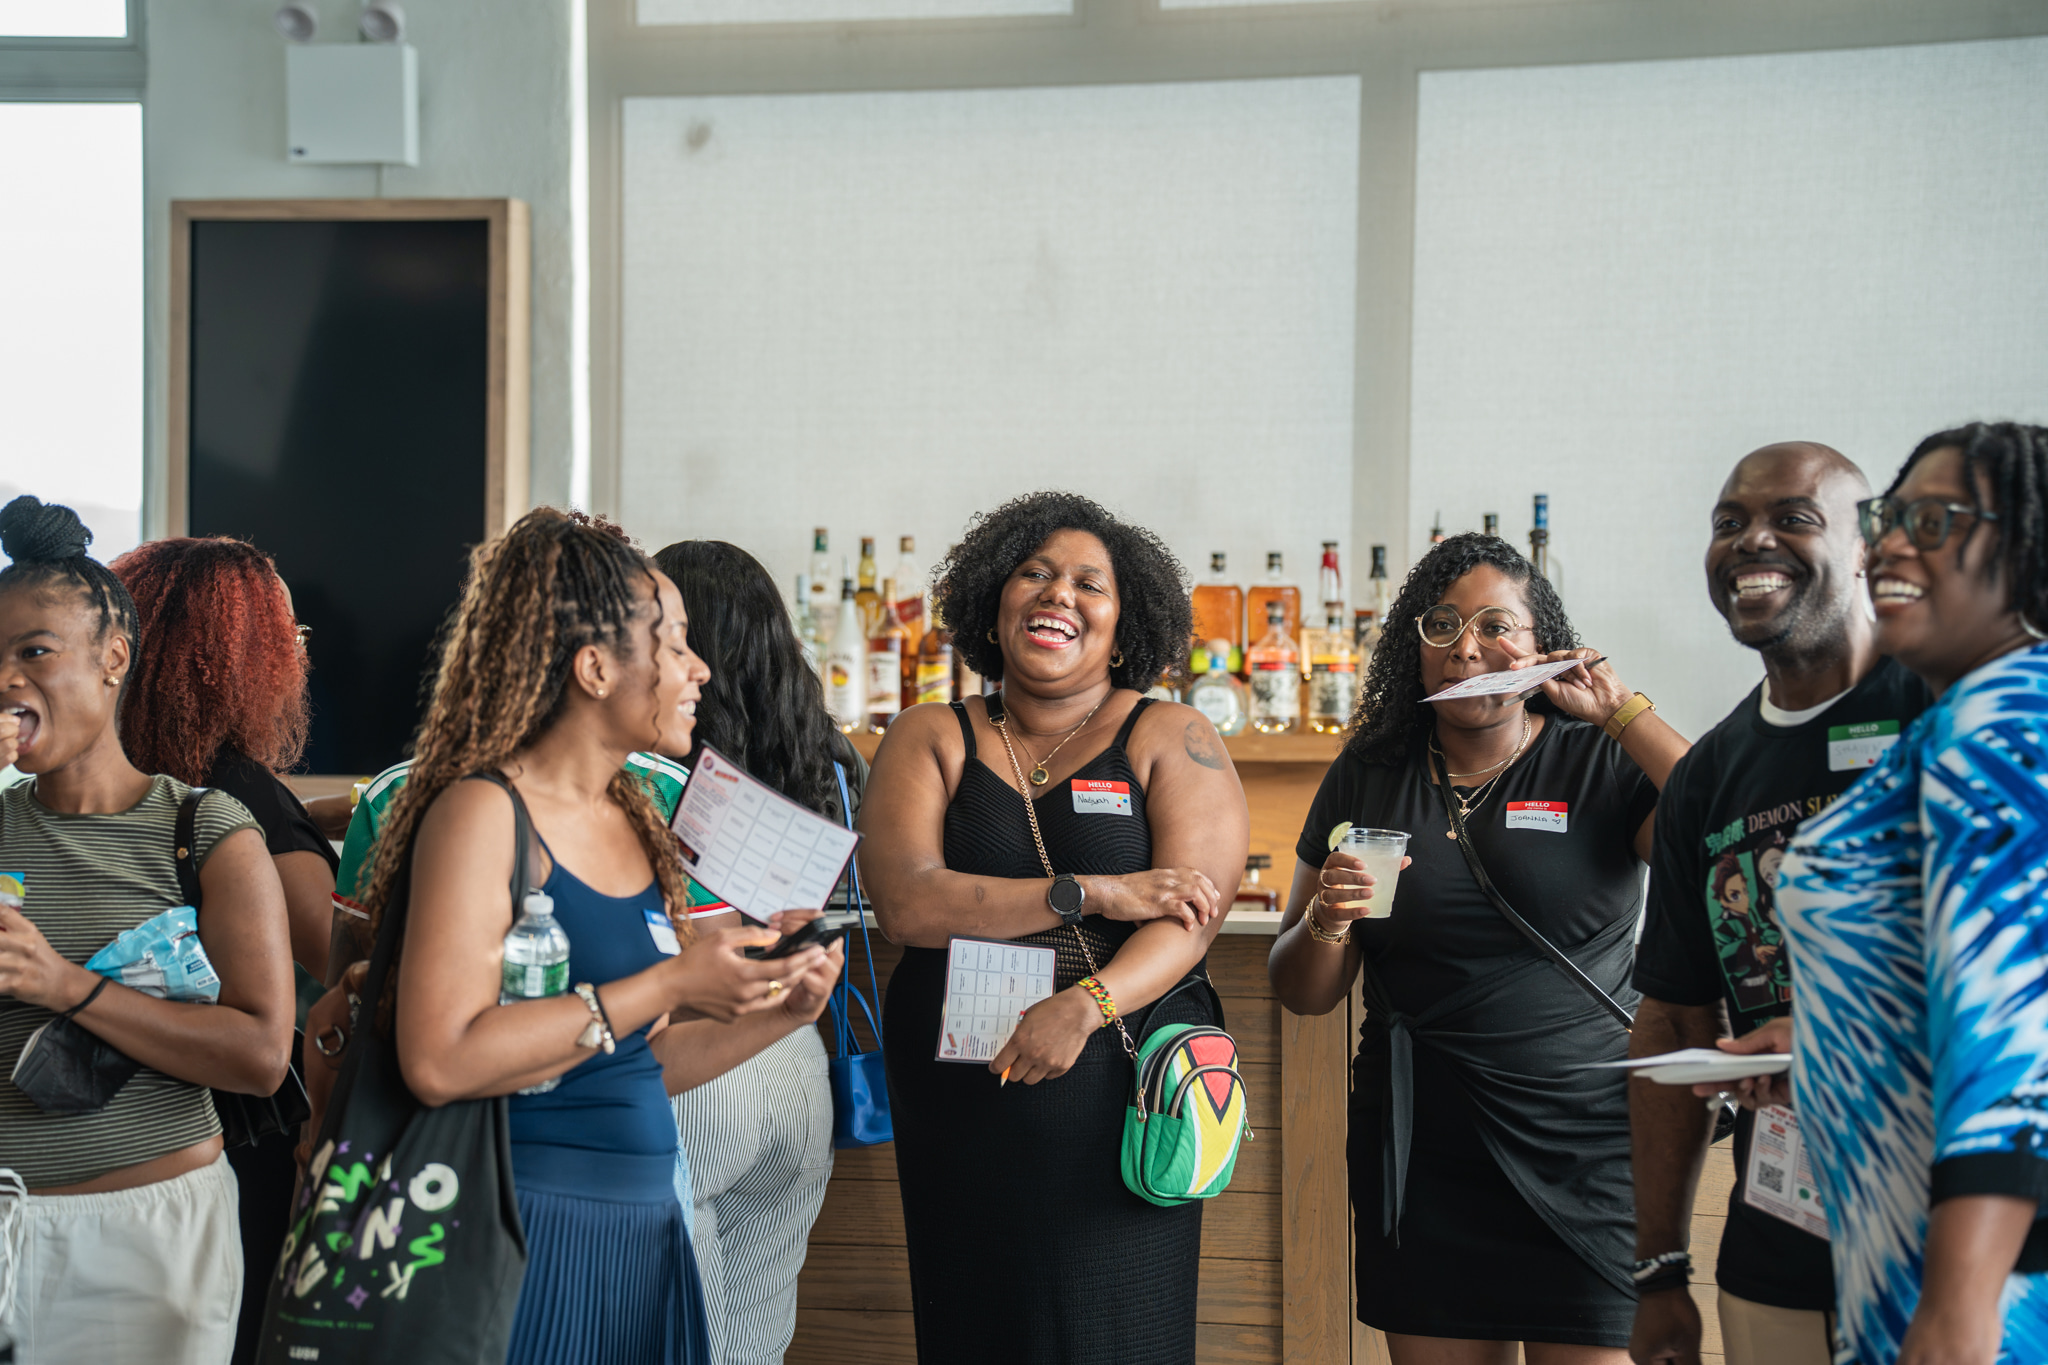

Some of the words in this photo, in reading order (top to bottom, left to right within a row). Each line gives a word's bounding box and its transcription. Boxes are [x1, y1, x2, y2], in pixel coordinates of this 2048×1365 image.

[1848, 723, 1879, 734] HELLO
[1747, 799, 1804, 834] DEMON
[288, 1345, 320, 1361] LUSH
